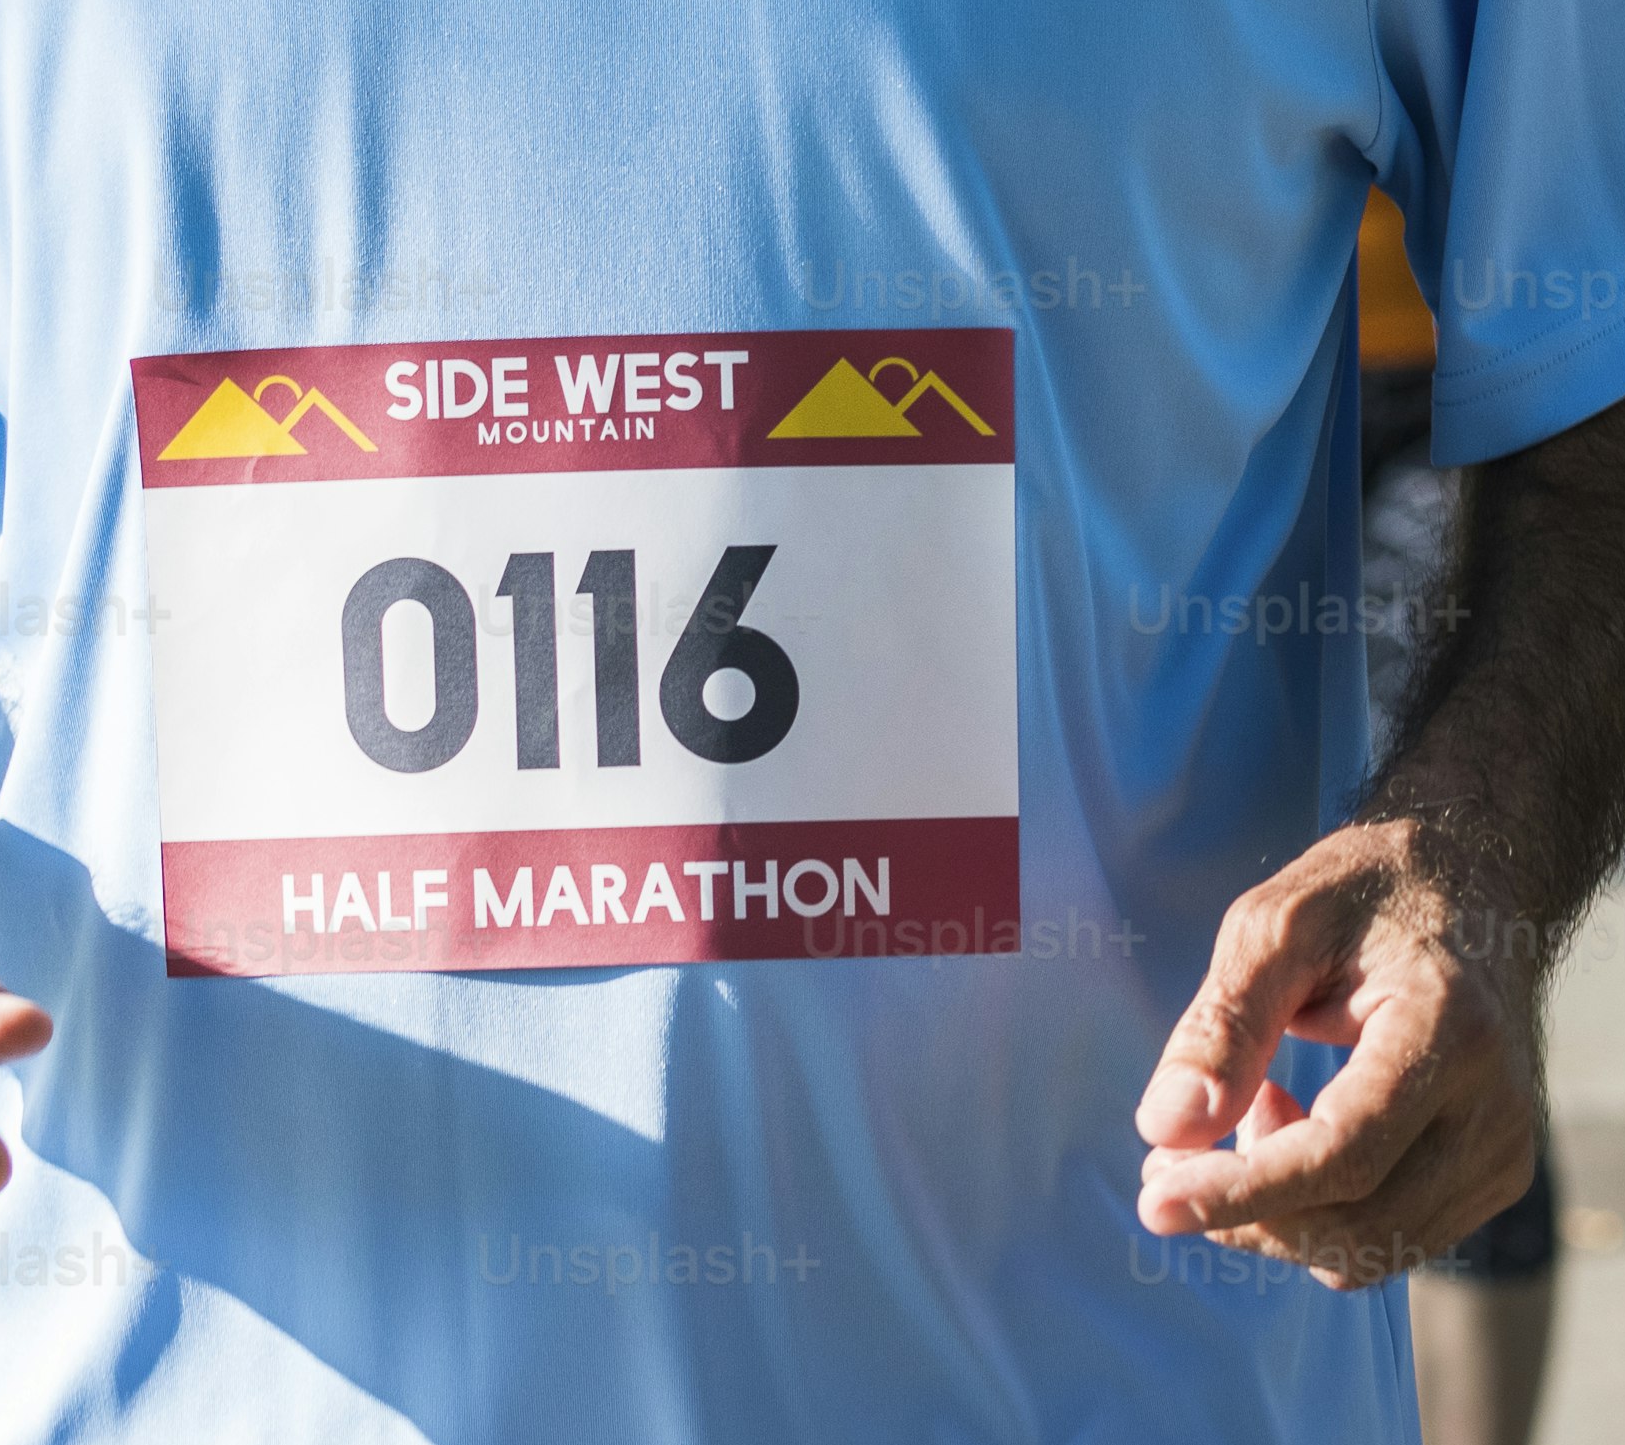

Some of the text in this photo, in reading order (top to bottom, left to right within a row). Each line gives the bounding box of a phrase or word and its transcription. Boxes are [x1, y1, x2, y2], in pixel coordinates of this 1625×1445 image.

[384, 350, 750, 421] SIDE WEST
[478, 417, 655, 446] MOUNTAIN
[341, 544, 800, 773] 0116
[282, 857, 891, 934] HALF MARATHON
